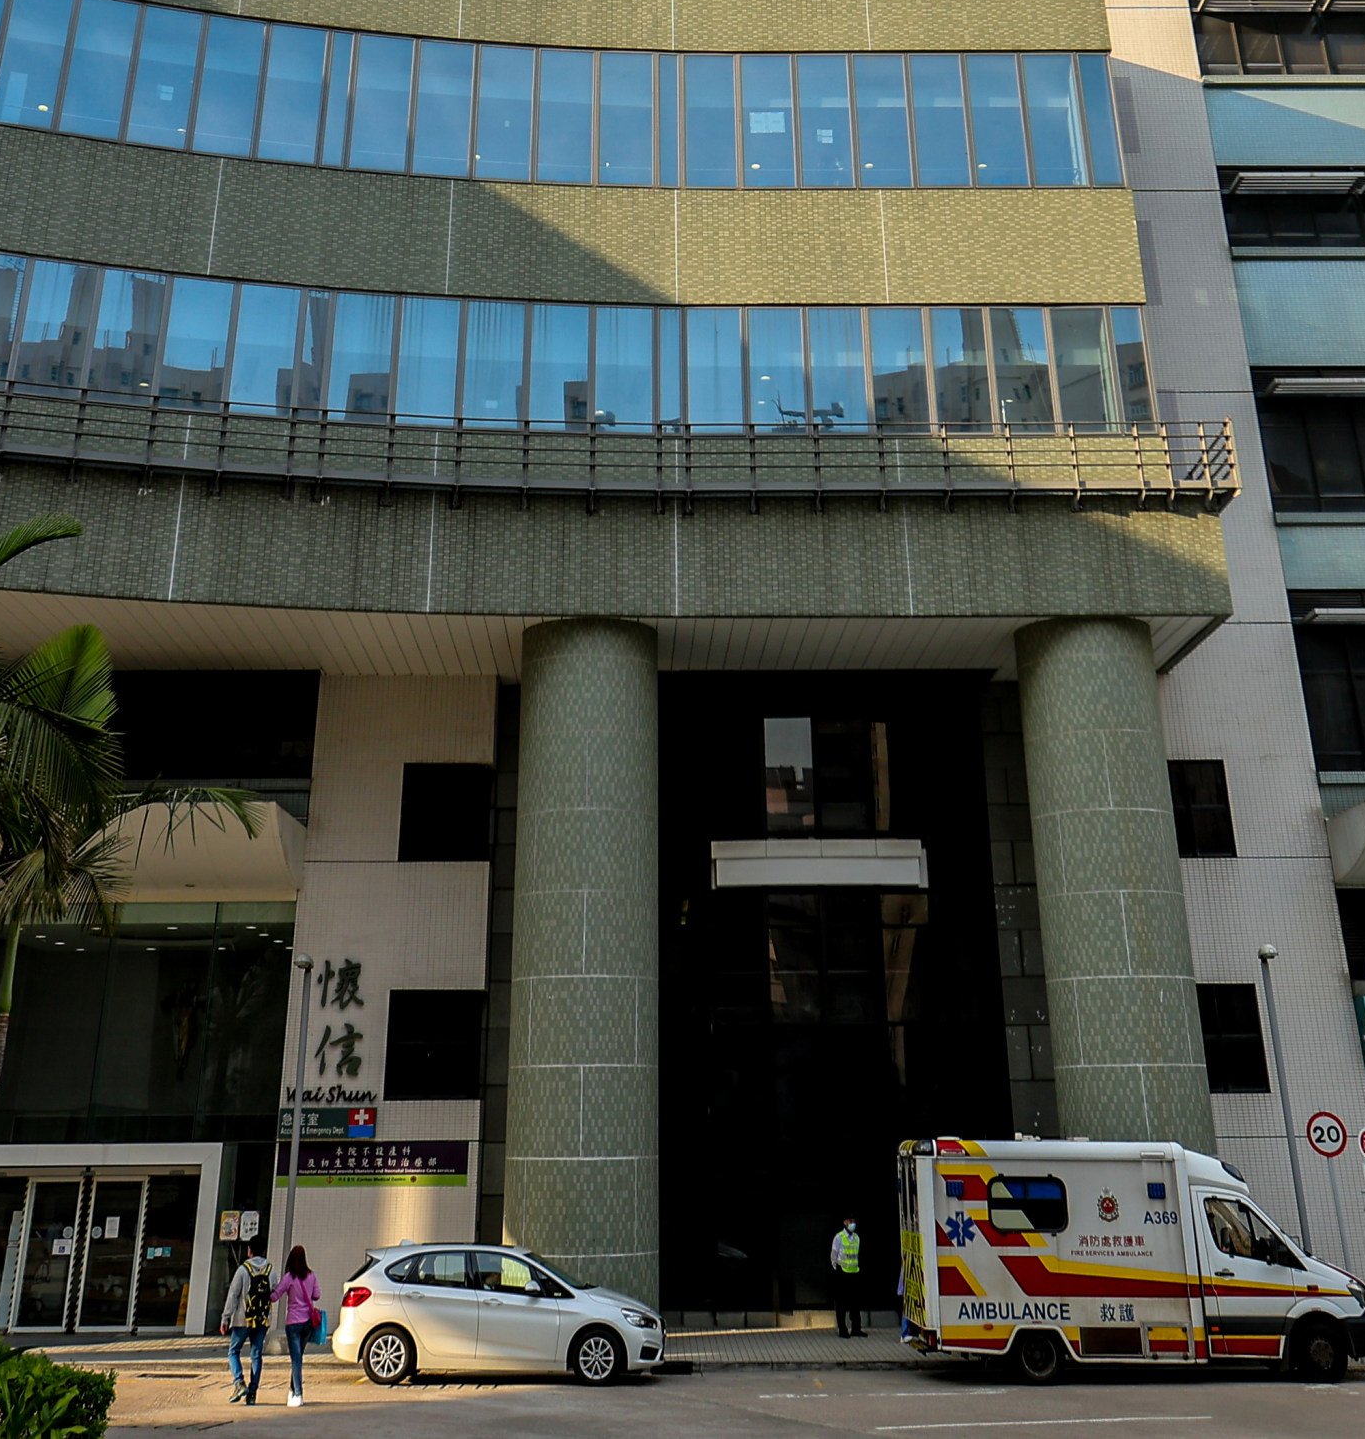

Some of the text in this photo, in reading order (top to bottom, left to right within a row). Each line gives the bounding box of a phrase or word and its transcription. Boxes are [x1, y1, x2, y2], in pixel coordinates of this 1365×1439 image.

[325, 1083, 377, 1102] Shun
[1313, 1125, 1340, 1143] 20
[1144, 1211, 1178, 1224] A369
[1078, 1234, 1145, 1247] 消防處救護車
[958, 1302, 1071, 1320] AMBULANCE
[1100, 1303, 1135, 1322] 救護
